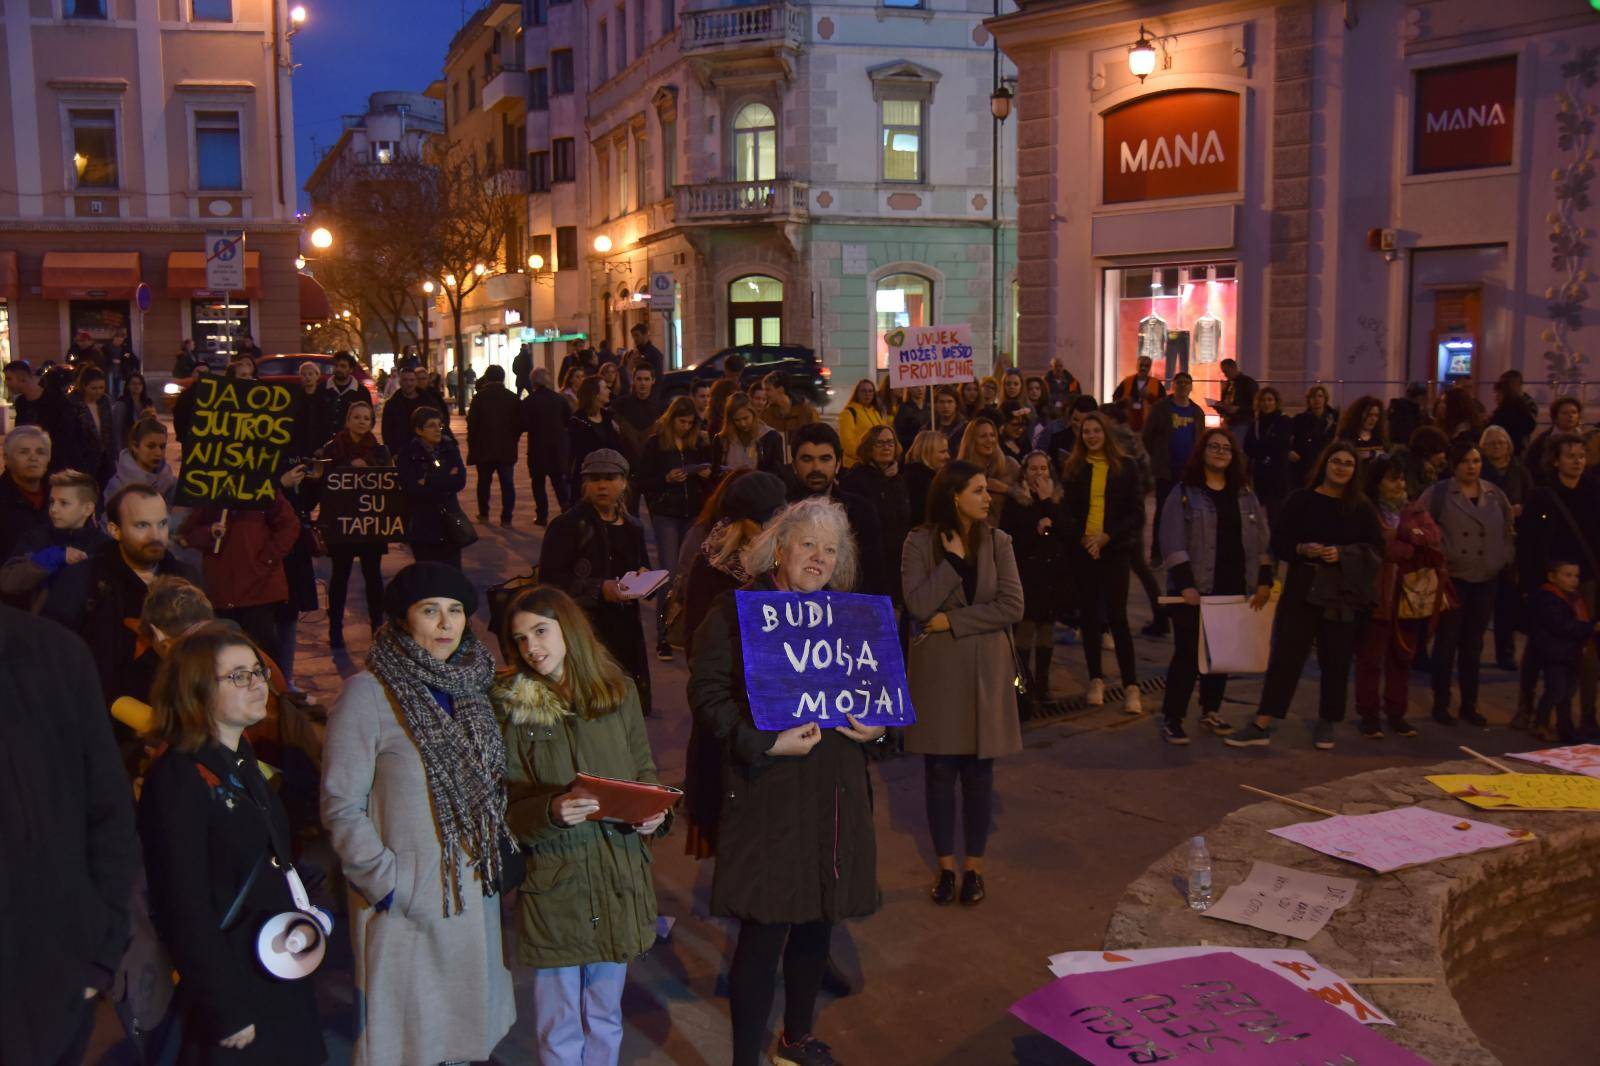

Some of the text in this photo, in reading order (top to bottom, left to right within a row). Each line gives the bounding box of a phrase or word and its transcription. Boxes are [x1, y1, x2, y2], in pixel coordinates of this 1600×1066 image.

[1426, 103, 1505, 133] MANA
[1120, 129, 1225, 174] MANA
[915, 330, 959, 346] UVIJEK
[196, 379, 292, 412] JA OD
[191, 410, 294, 444] JUTROS
[183, 470, 276, 500] STALA
[358, 494, 385, 512] SU
[337, 516, 405, 535] TAPIJA
